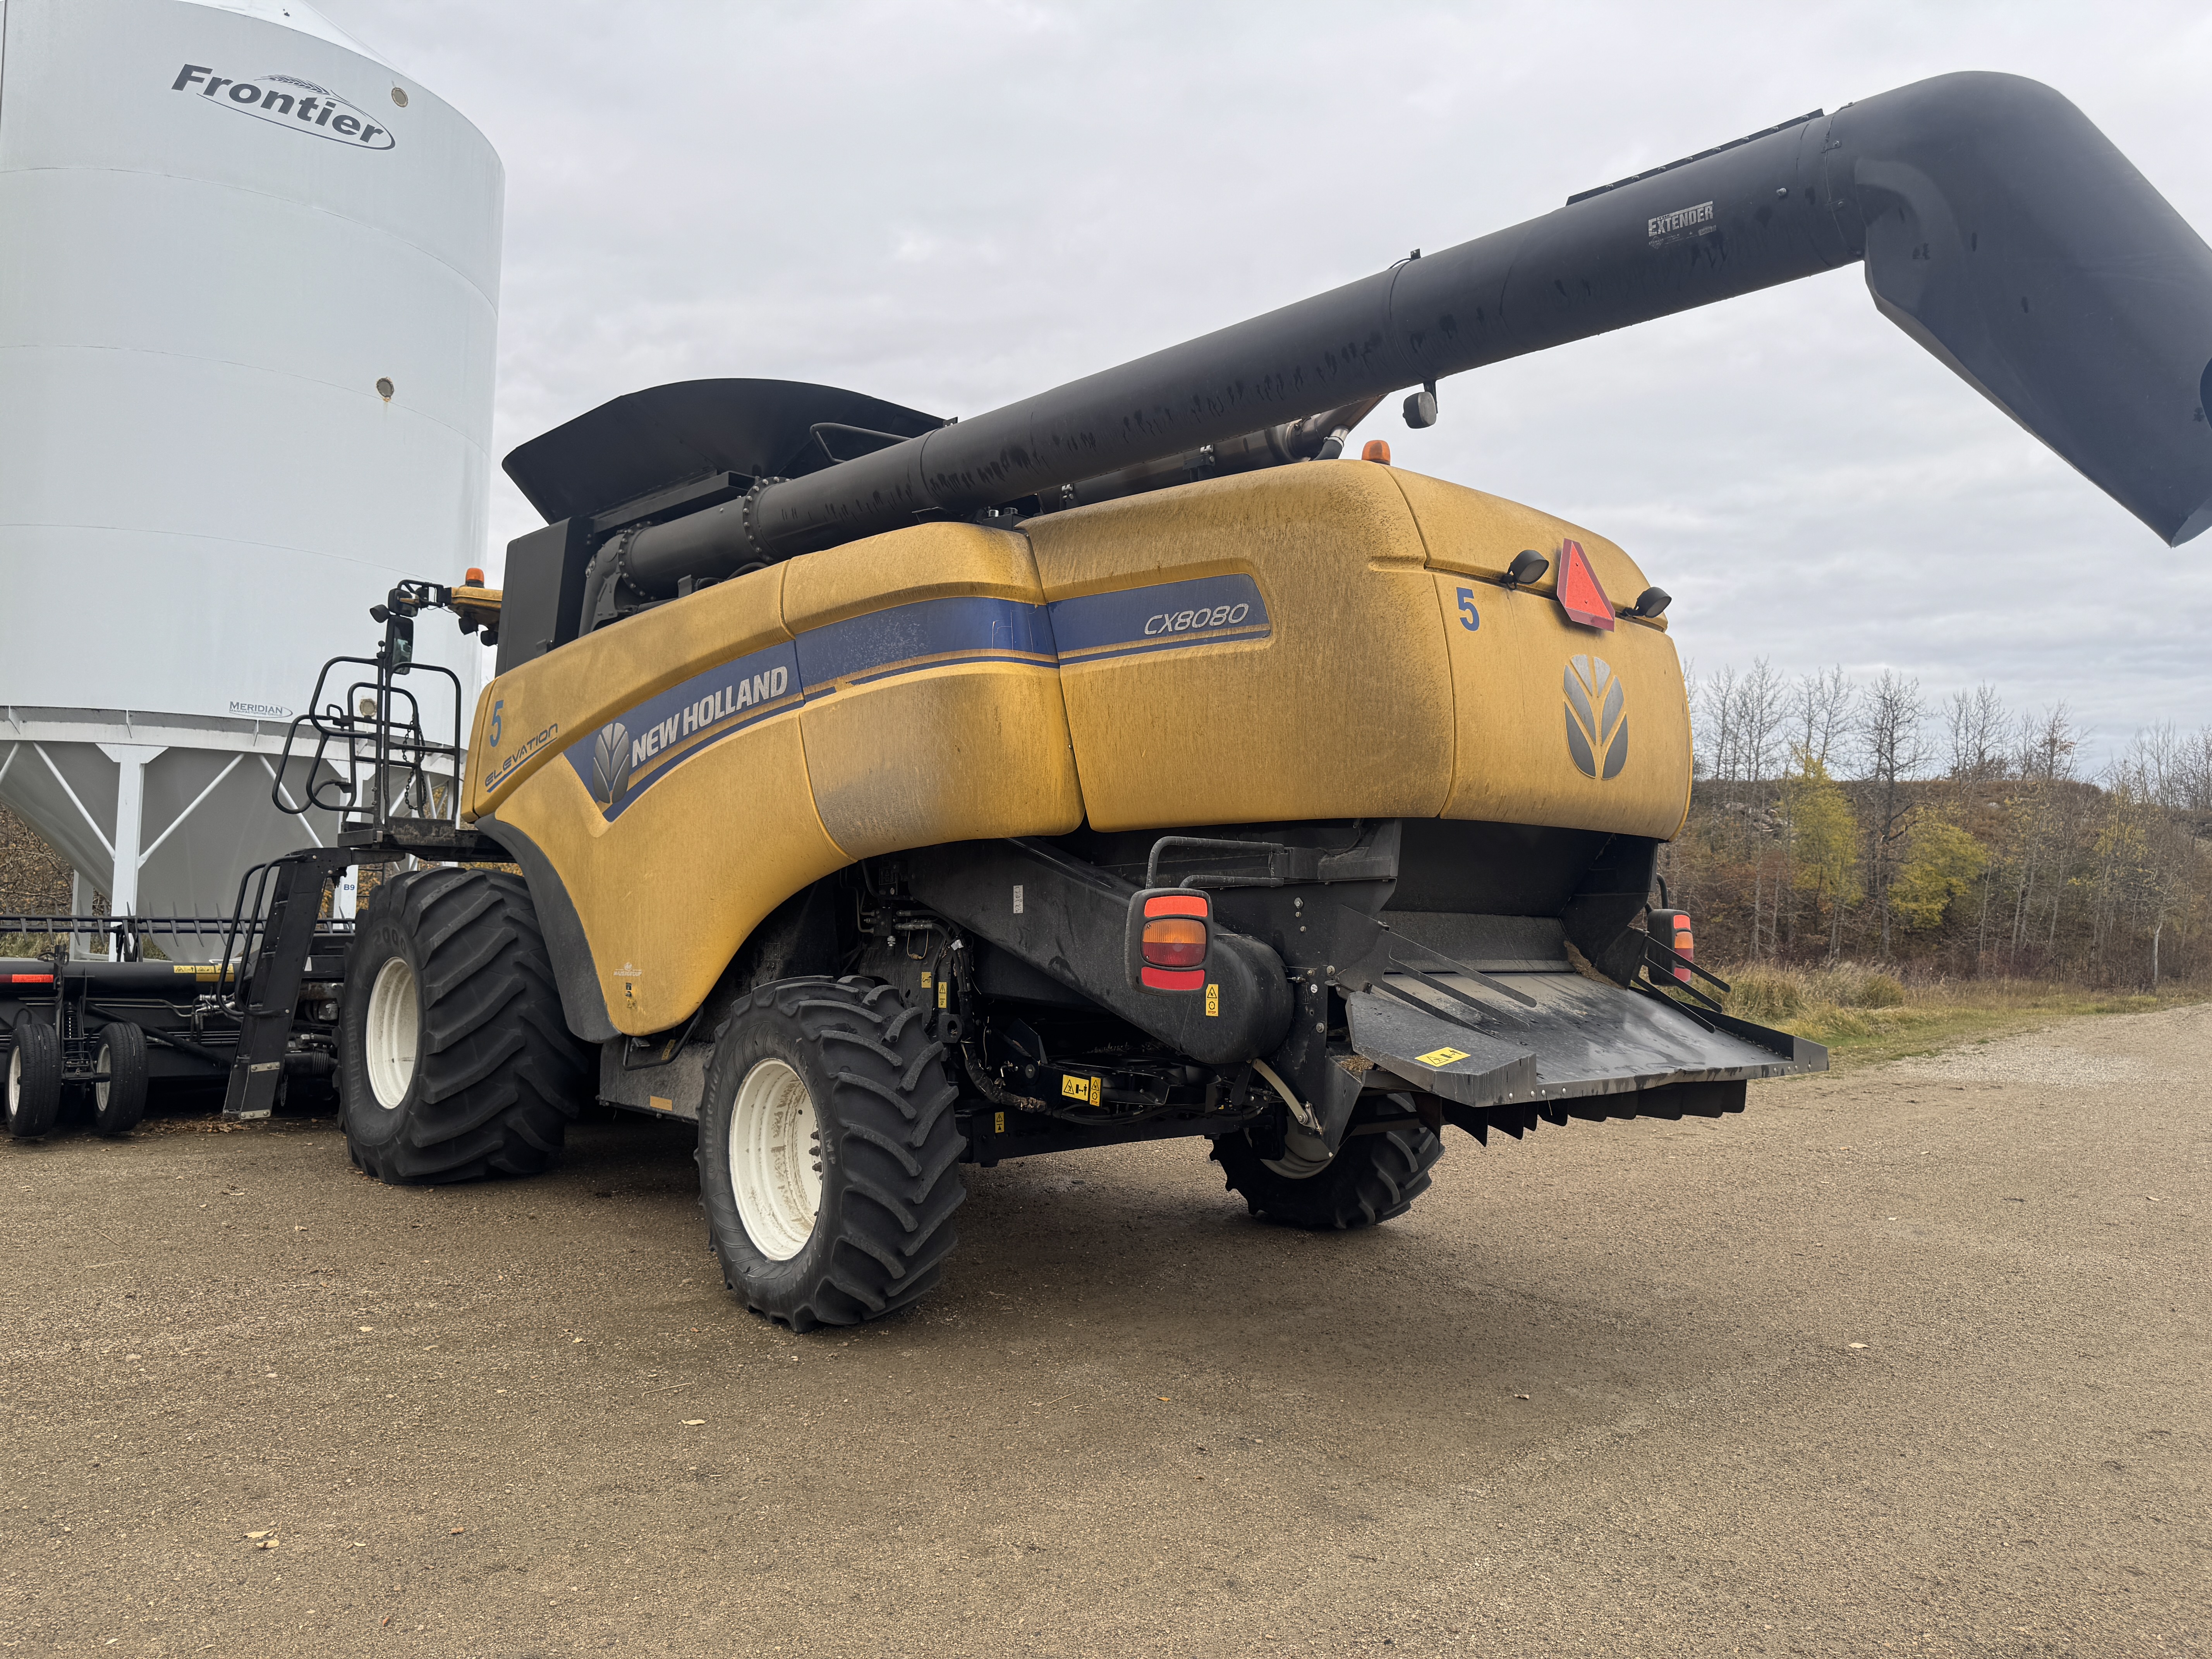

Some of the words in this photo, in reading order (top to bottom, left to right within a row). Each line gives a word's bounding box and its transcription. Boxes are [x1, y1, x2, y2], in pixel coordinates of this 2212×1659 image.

[171, 64, 384, 143] Frontier
[1648, 205, 1713, 237] EXTENDER
[1144, 603, 1249, 635] CX8080
[1456, 587, 1480, 631] 5
[229, 701, 283, 714] MERIDIAN
[489, 699, 504, 747] 5
[632, 713, 680, 768] NEW
[683, 666, 788, 736] HOLLAND
[485, 723, 558, 788] ELEVATION
